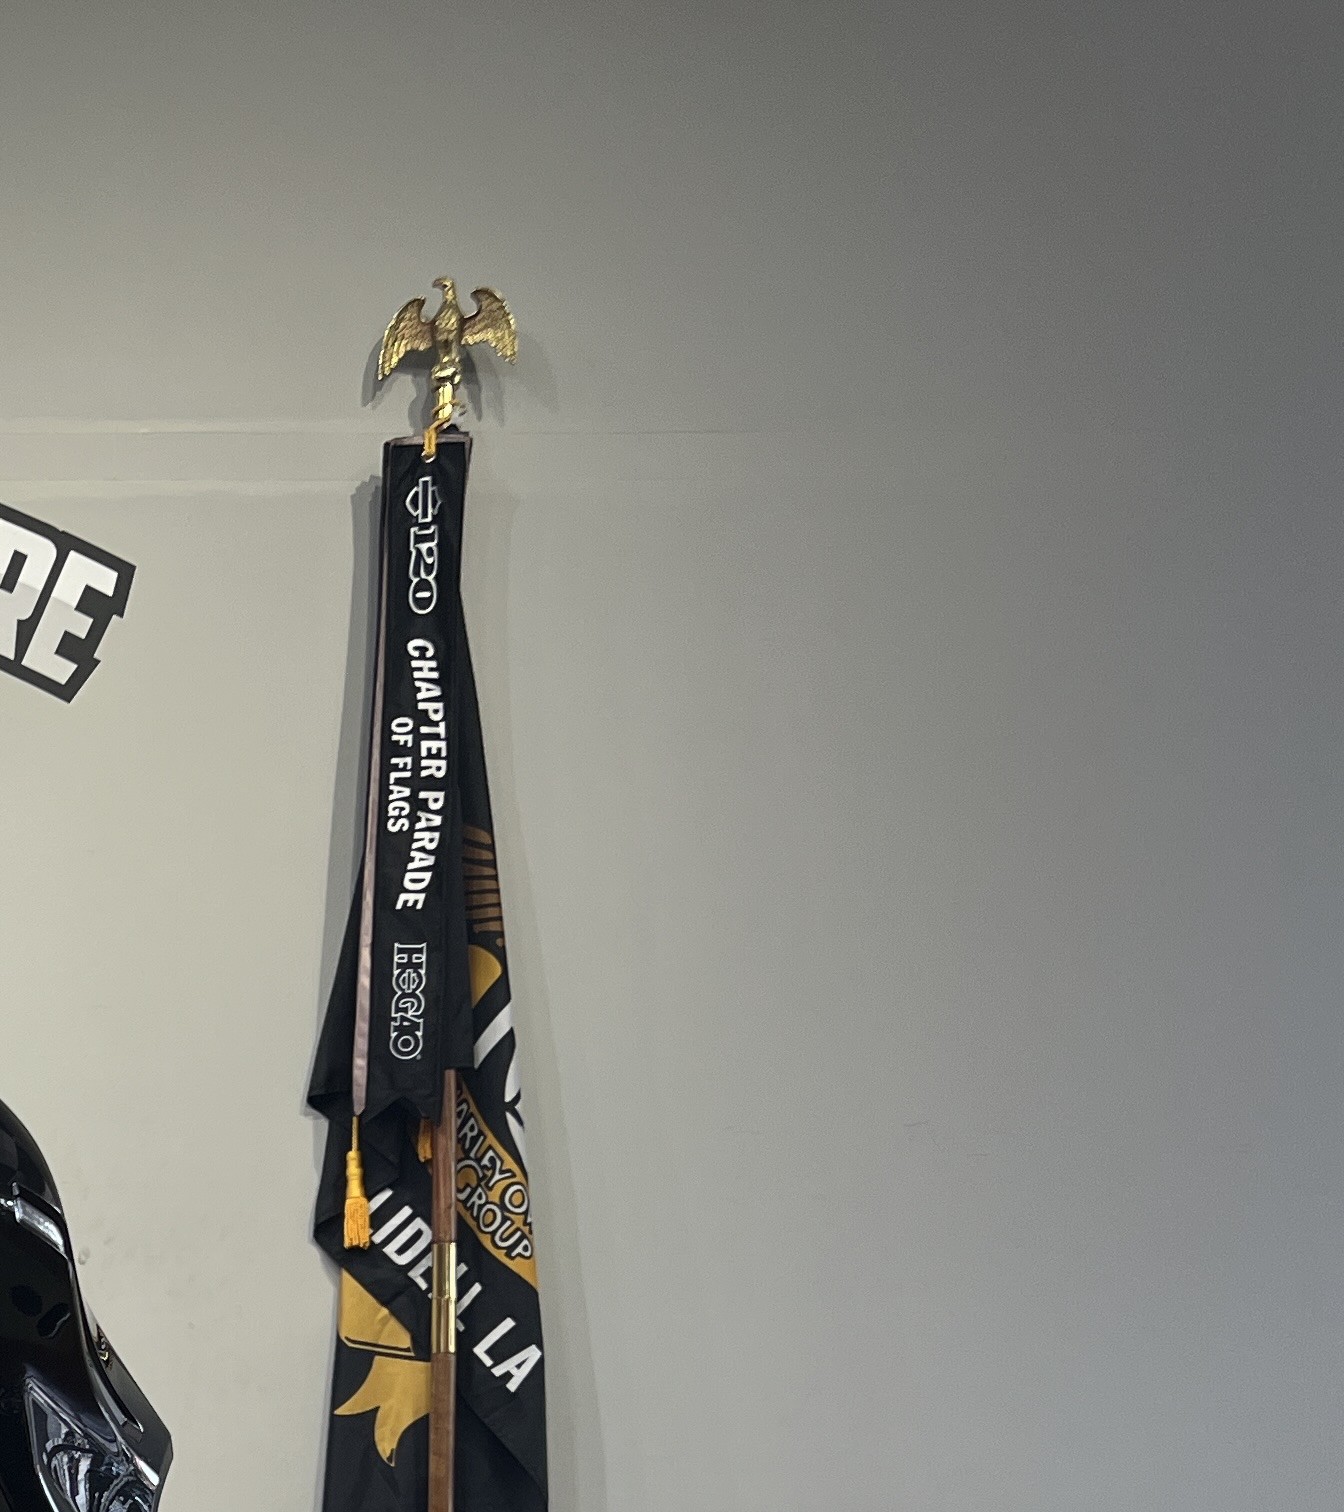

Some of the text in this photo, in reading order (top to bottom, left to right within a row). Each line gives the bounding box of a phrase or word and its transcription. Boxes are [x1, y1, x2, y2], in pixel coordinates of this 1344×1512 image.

[408, 524, 440, 615] 120
[387, 716, 413, 833] OF FLAGS
[395, 638, 447, 910] CHAPTER PARADE
[456, 1092, 515, 1187] ARLEY
[457, 1159, 533, 1258] GROUP
[473, 1316, 543, 1393] LA
